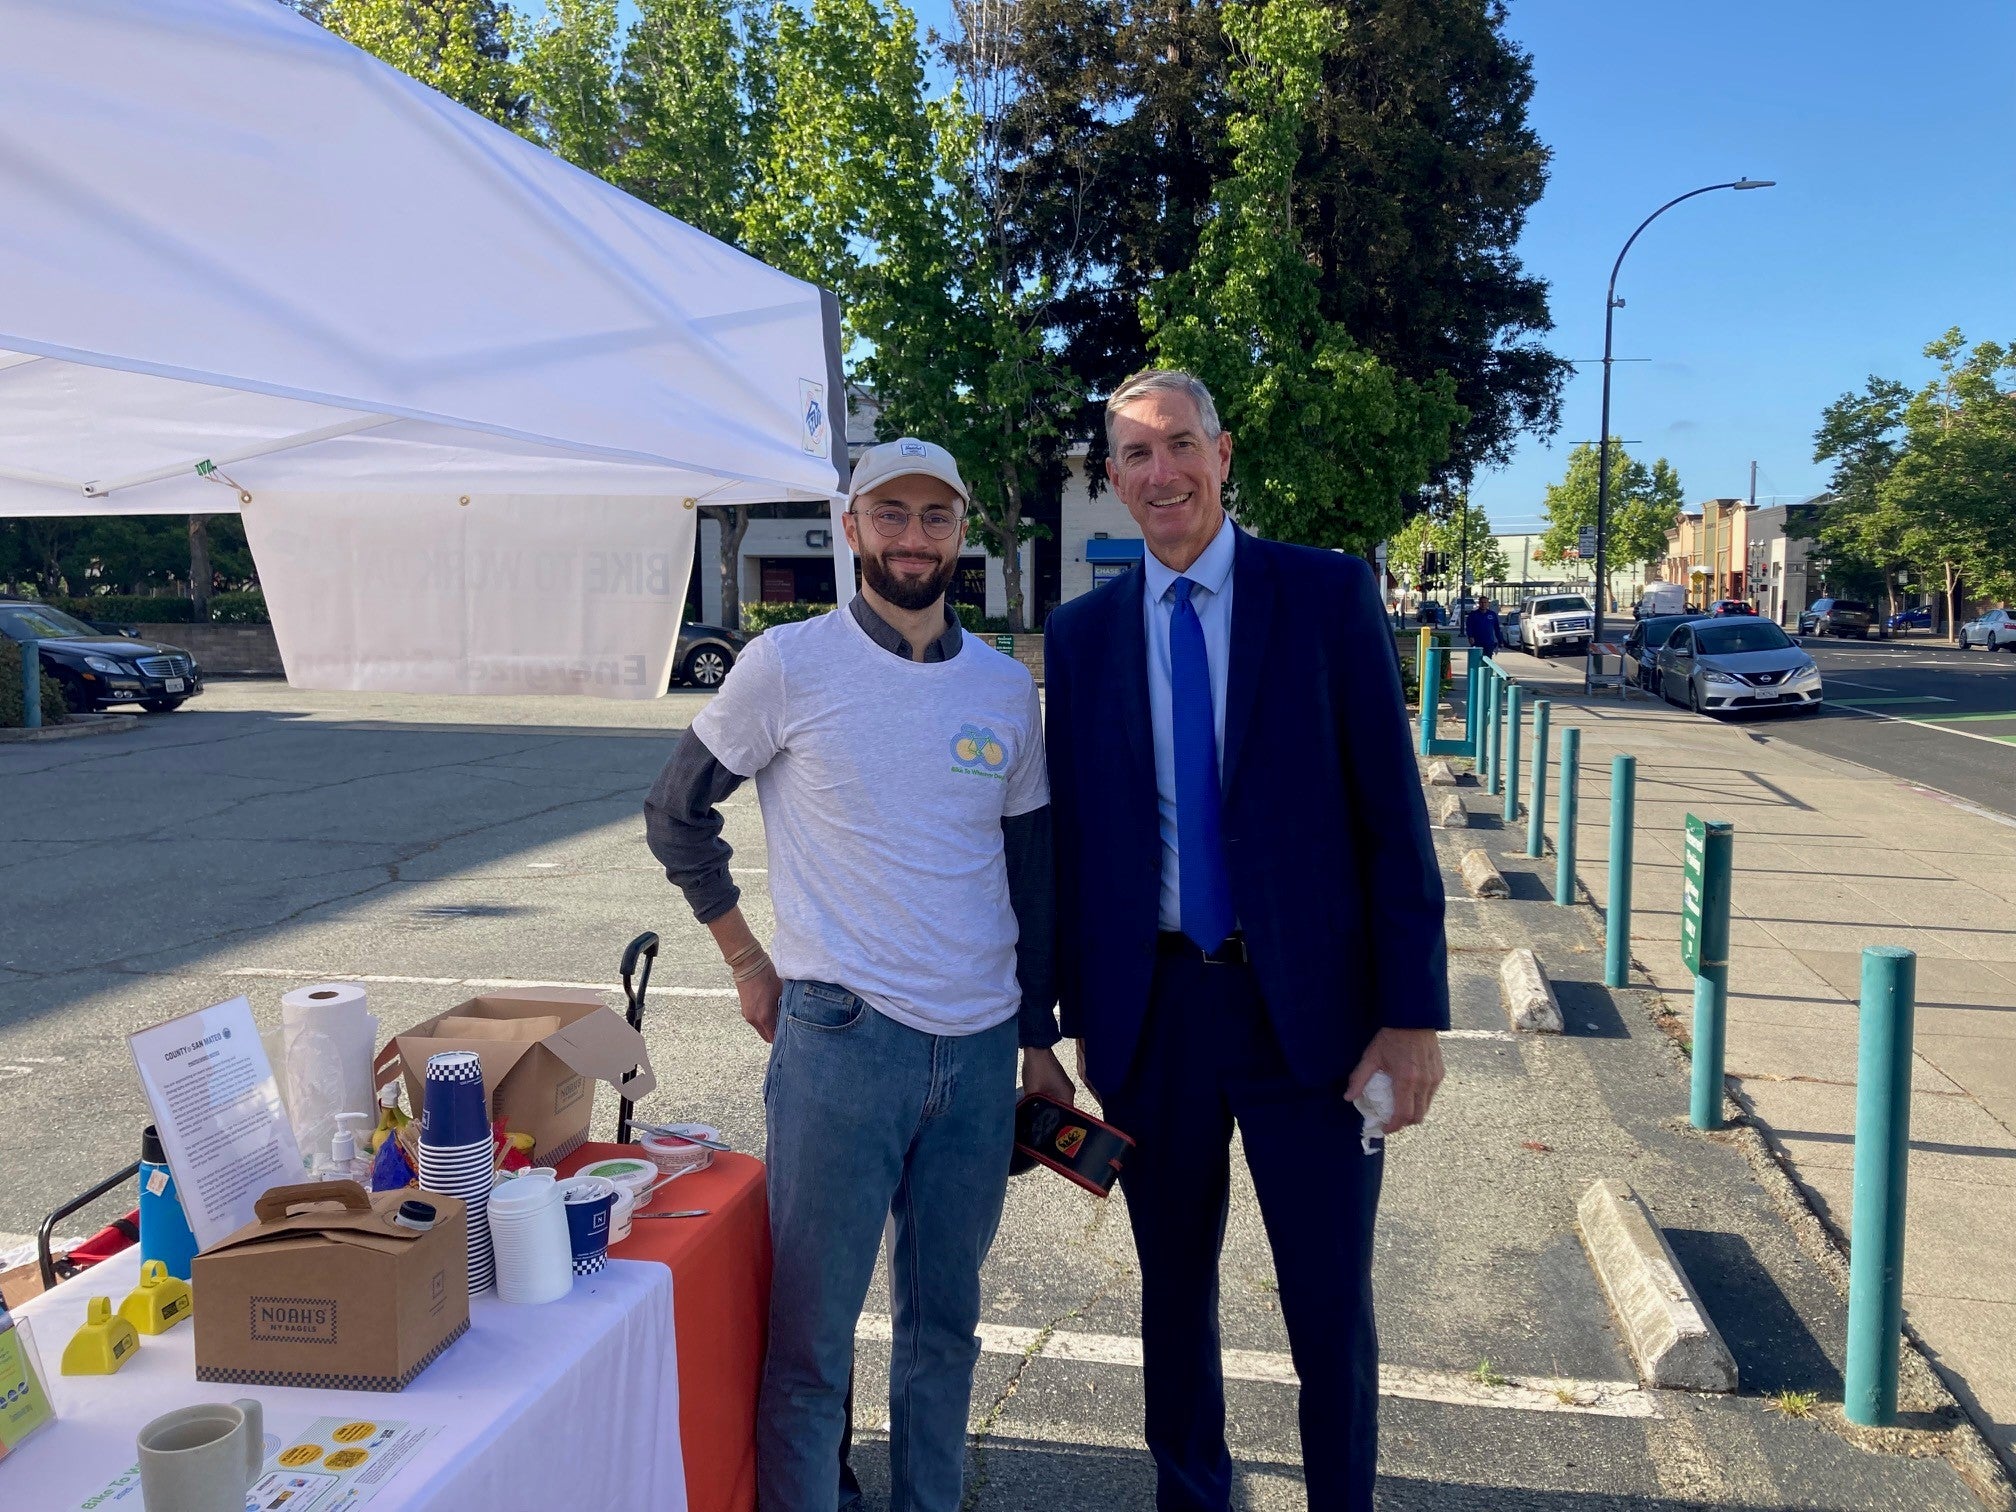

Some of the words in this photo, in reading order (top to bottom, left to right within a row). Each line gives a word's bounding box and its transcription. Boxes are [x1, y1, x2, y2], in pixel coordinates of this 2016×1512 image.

[164, 1046, 188, 1061] COUNTY
[191, 1040, 204, 1051] SAN
[203, 1032, 222, 1046] MATEO
[262, 1308, 326, 1324] NOAH'S
[285, 1325, 317, 1333] BAGELS
[81, 1489, 115, 1509] Bike
[108, 1477, 131, 1486] To
